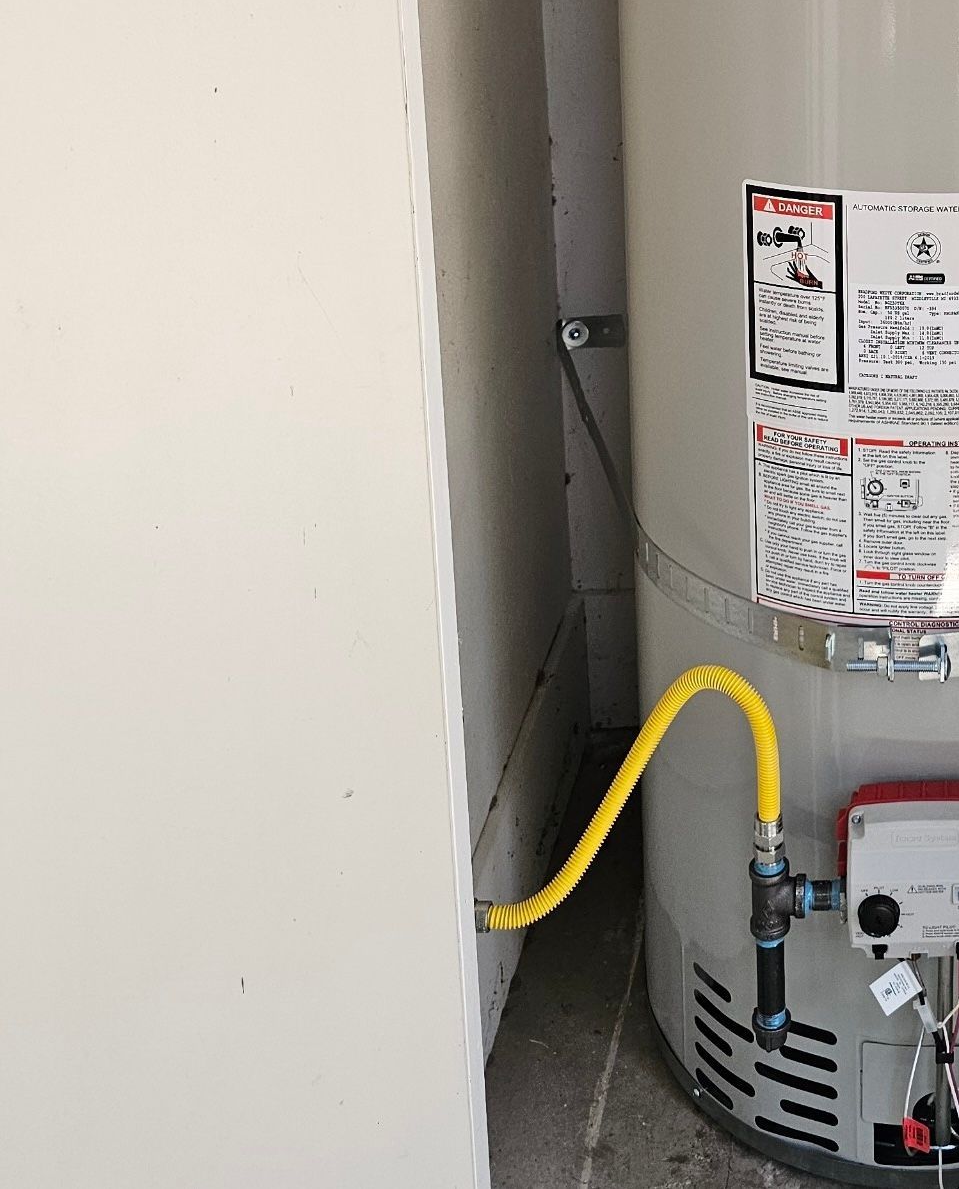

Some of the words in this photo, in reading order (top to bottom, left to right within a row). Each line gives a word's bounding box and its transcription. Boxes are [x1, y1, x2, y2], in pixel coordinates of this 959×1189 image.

[778, 202, 823, 216] DANGER
[852, 204, 896, 212] AUTOMATIC
[792, 252, 808, 260] HOT
[800, 278, 818, 286] BURN
[780, 438, 802, 448] BEFORE
[804, 444, 838, 452] OPERATING
